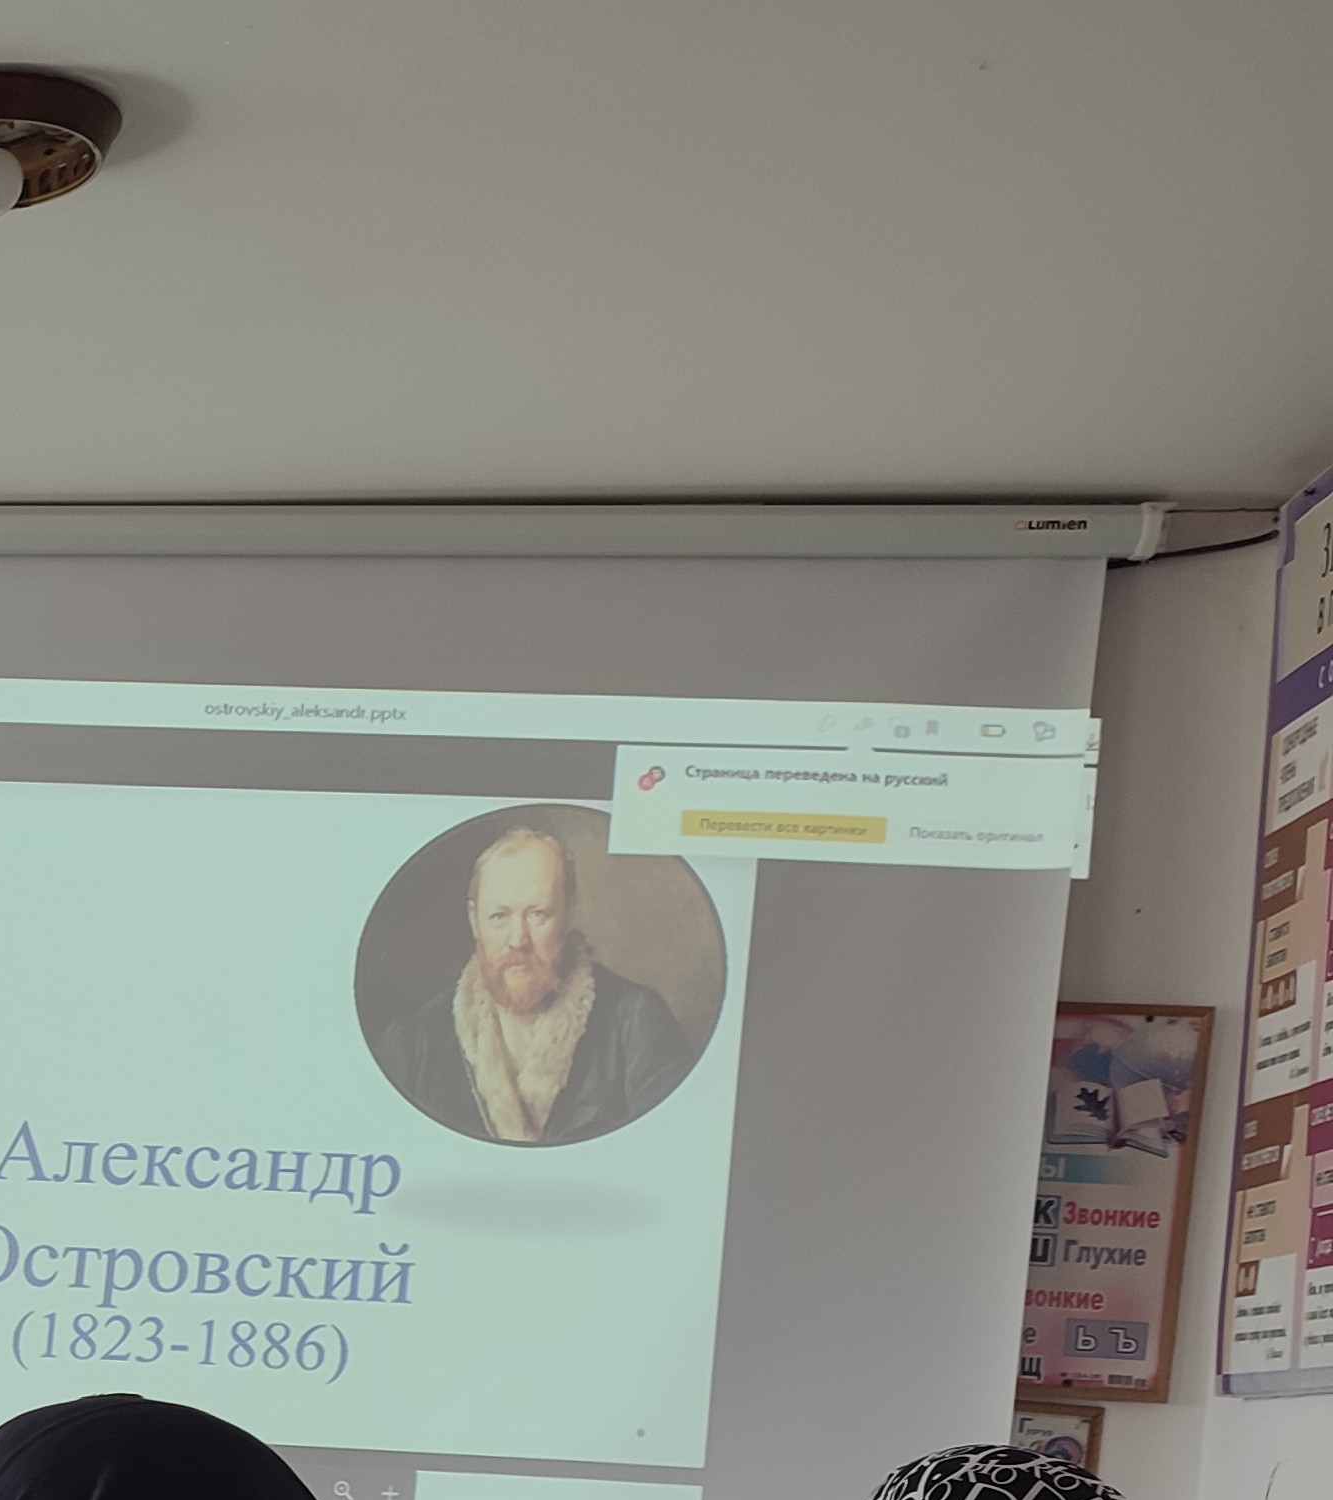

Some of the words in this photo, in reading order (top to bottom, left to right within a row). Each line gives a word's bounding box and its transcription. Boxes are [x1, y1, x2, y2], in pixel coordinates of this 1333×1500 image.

[685, 764, 760, 781] Страница
[1062, 1201, 1161, 1229] Звонкие
[1062, 1239, 1147, 1270] Глухие
[1024, 1288, 1105, 1311] вонкие
[11, 1310, 349, 1385] (1823-1886)
